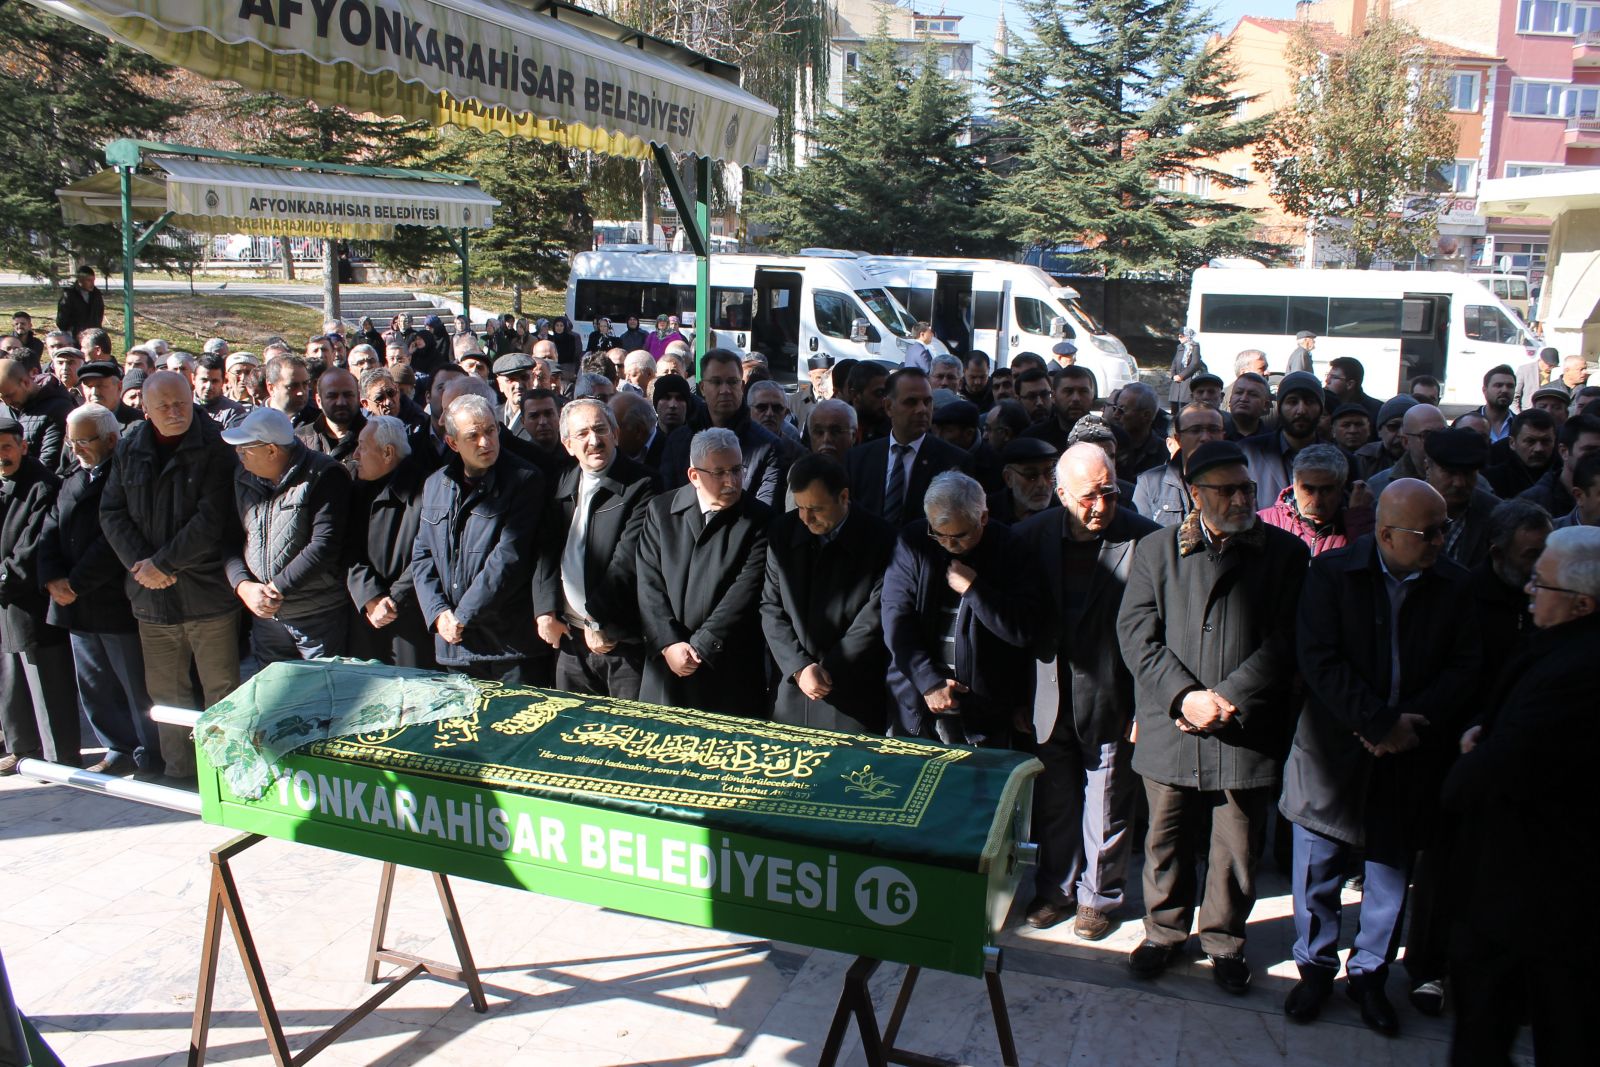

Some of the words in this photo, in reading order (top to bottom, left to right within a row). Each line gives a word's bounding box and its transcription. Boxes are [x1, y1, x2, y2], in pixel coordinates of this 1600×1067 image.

[584, 77, 696, 137] BELEDİYESİ
[375, 204, 440, 221] BELEDİYESİ
[557, 754, 573, 762] can
[574, 755, 604, 766] ölümü
[653, 767, 680, 775] sonra
[700, 773, 721, 781] geri
[269, 764, 569, 864] YONKARAHİSAR
[580, 823, 838, 912] BELEDİYESİ
[860, 876, 912, 915] 16
